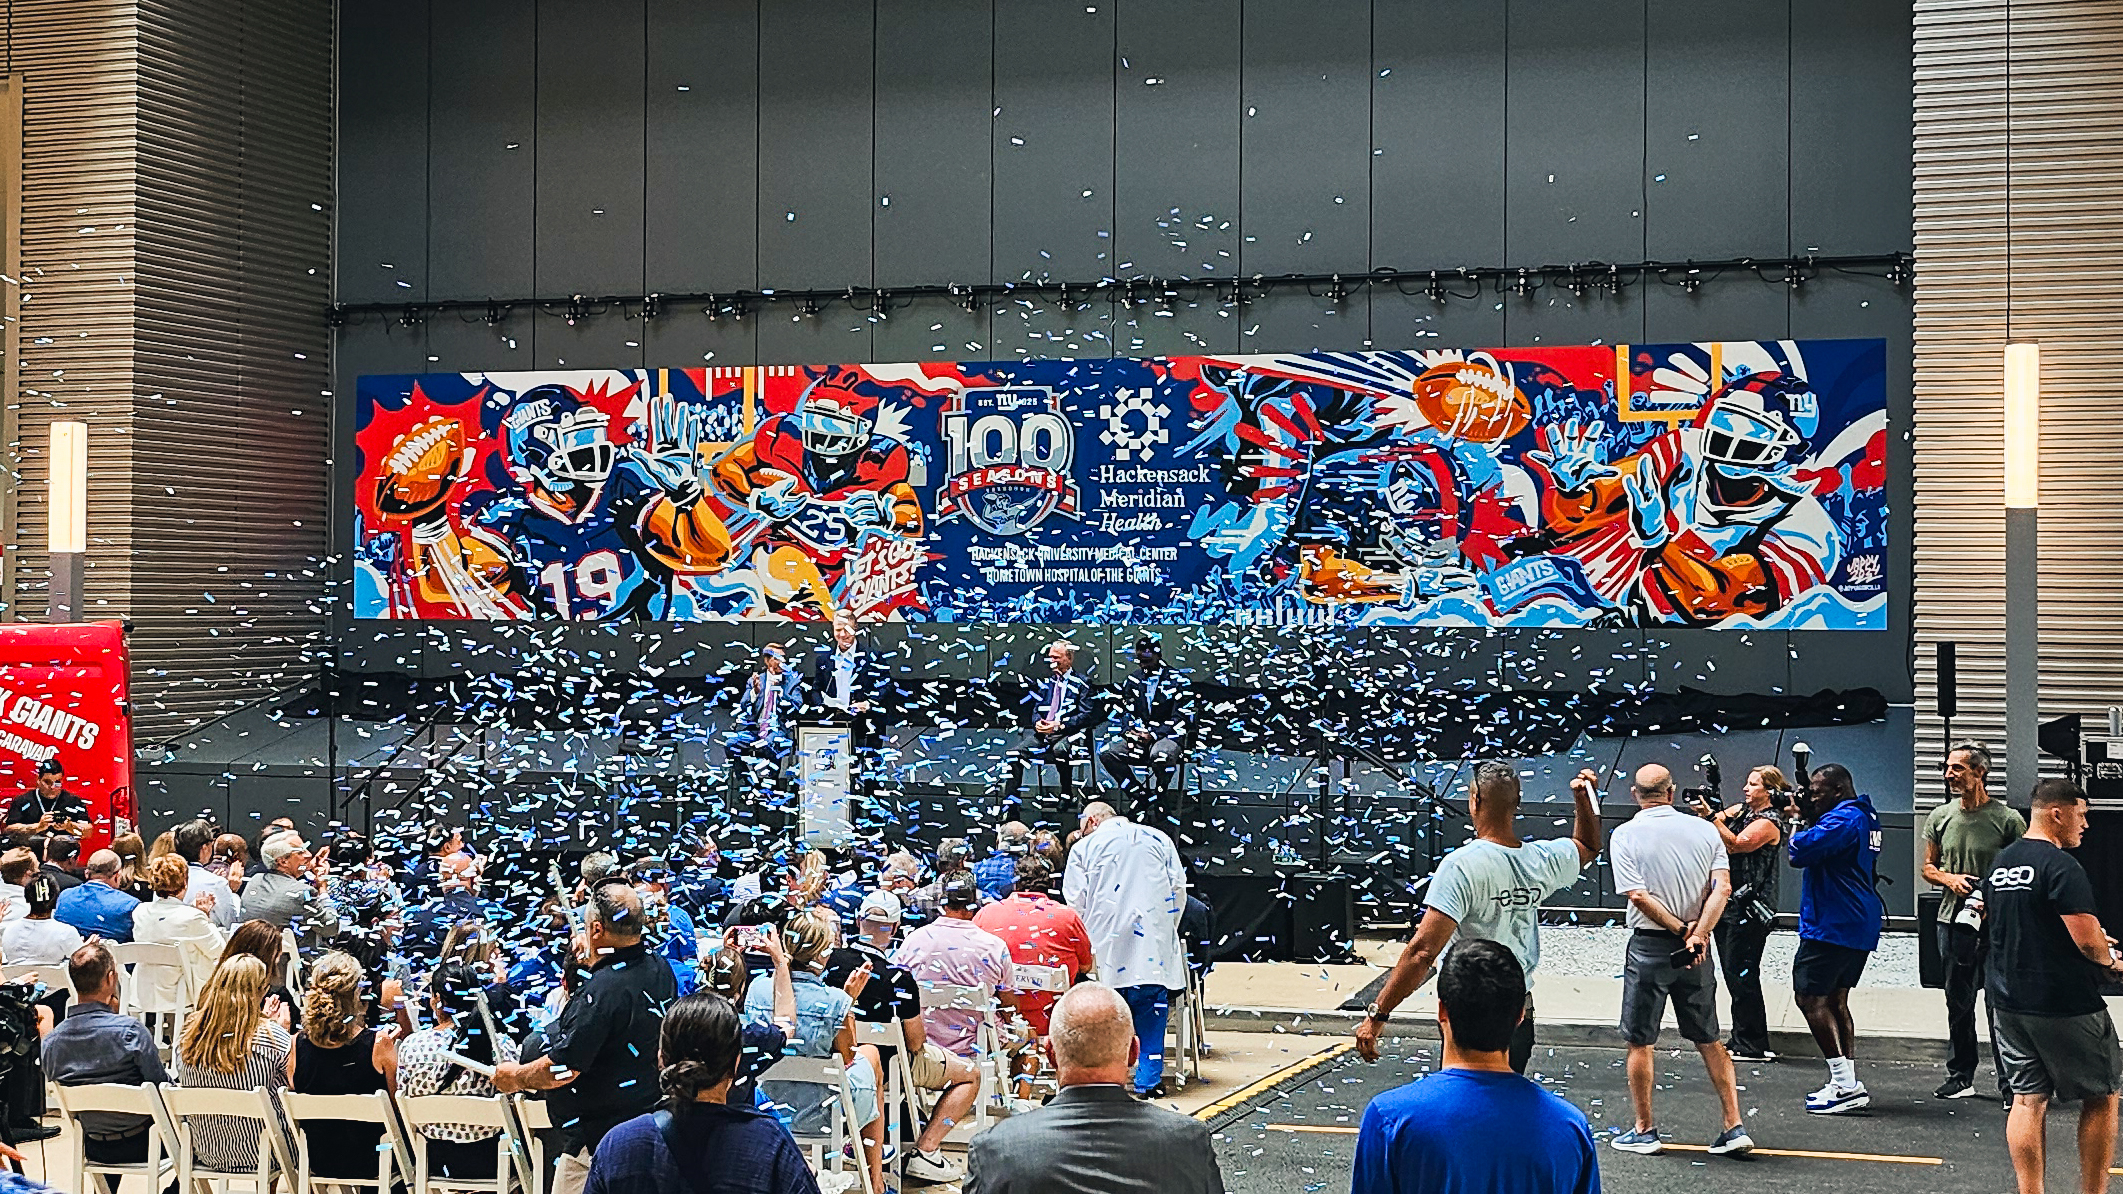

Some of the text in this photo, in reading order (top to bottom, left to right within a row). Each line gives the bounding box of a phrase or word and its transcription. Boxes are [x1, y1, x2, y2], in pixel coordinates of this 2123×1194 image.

[1018, 397, 1038, 406] 925
[511, 399, 552, 430] GIANTS
[946, 413, 1069, 477] 100
[957, 467, 1058, 492] SEASONS
[1099, 463, 1212, 484] Hackensack
[1099, 488, 1186, 508] Meridian
[800, 508, 846, 541] 25
[1098, 511, 1163, 532] Health
[971, 546, 1036, 561] HACKENSACK
[1037, 546, 1094, 561] UNIVERSITY
[1140, 546, 1178, 561] CENTER
[540, 549, 624, 621] 19
[985, 567, 1044, 583] HOMETOWN
[1044, 567, 1090, 583] HOSPITAL
[1104, 567, 1124, 583] THE
[1494, 558, 1555, 596] GIANTS
[8, 695, 100, 750] GIANTS
